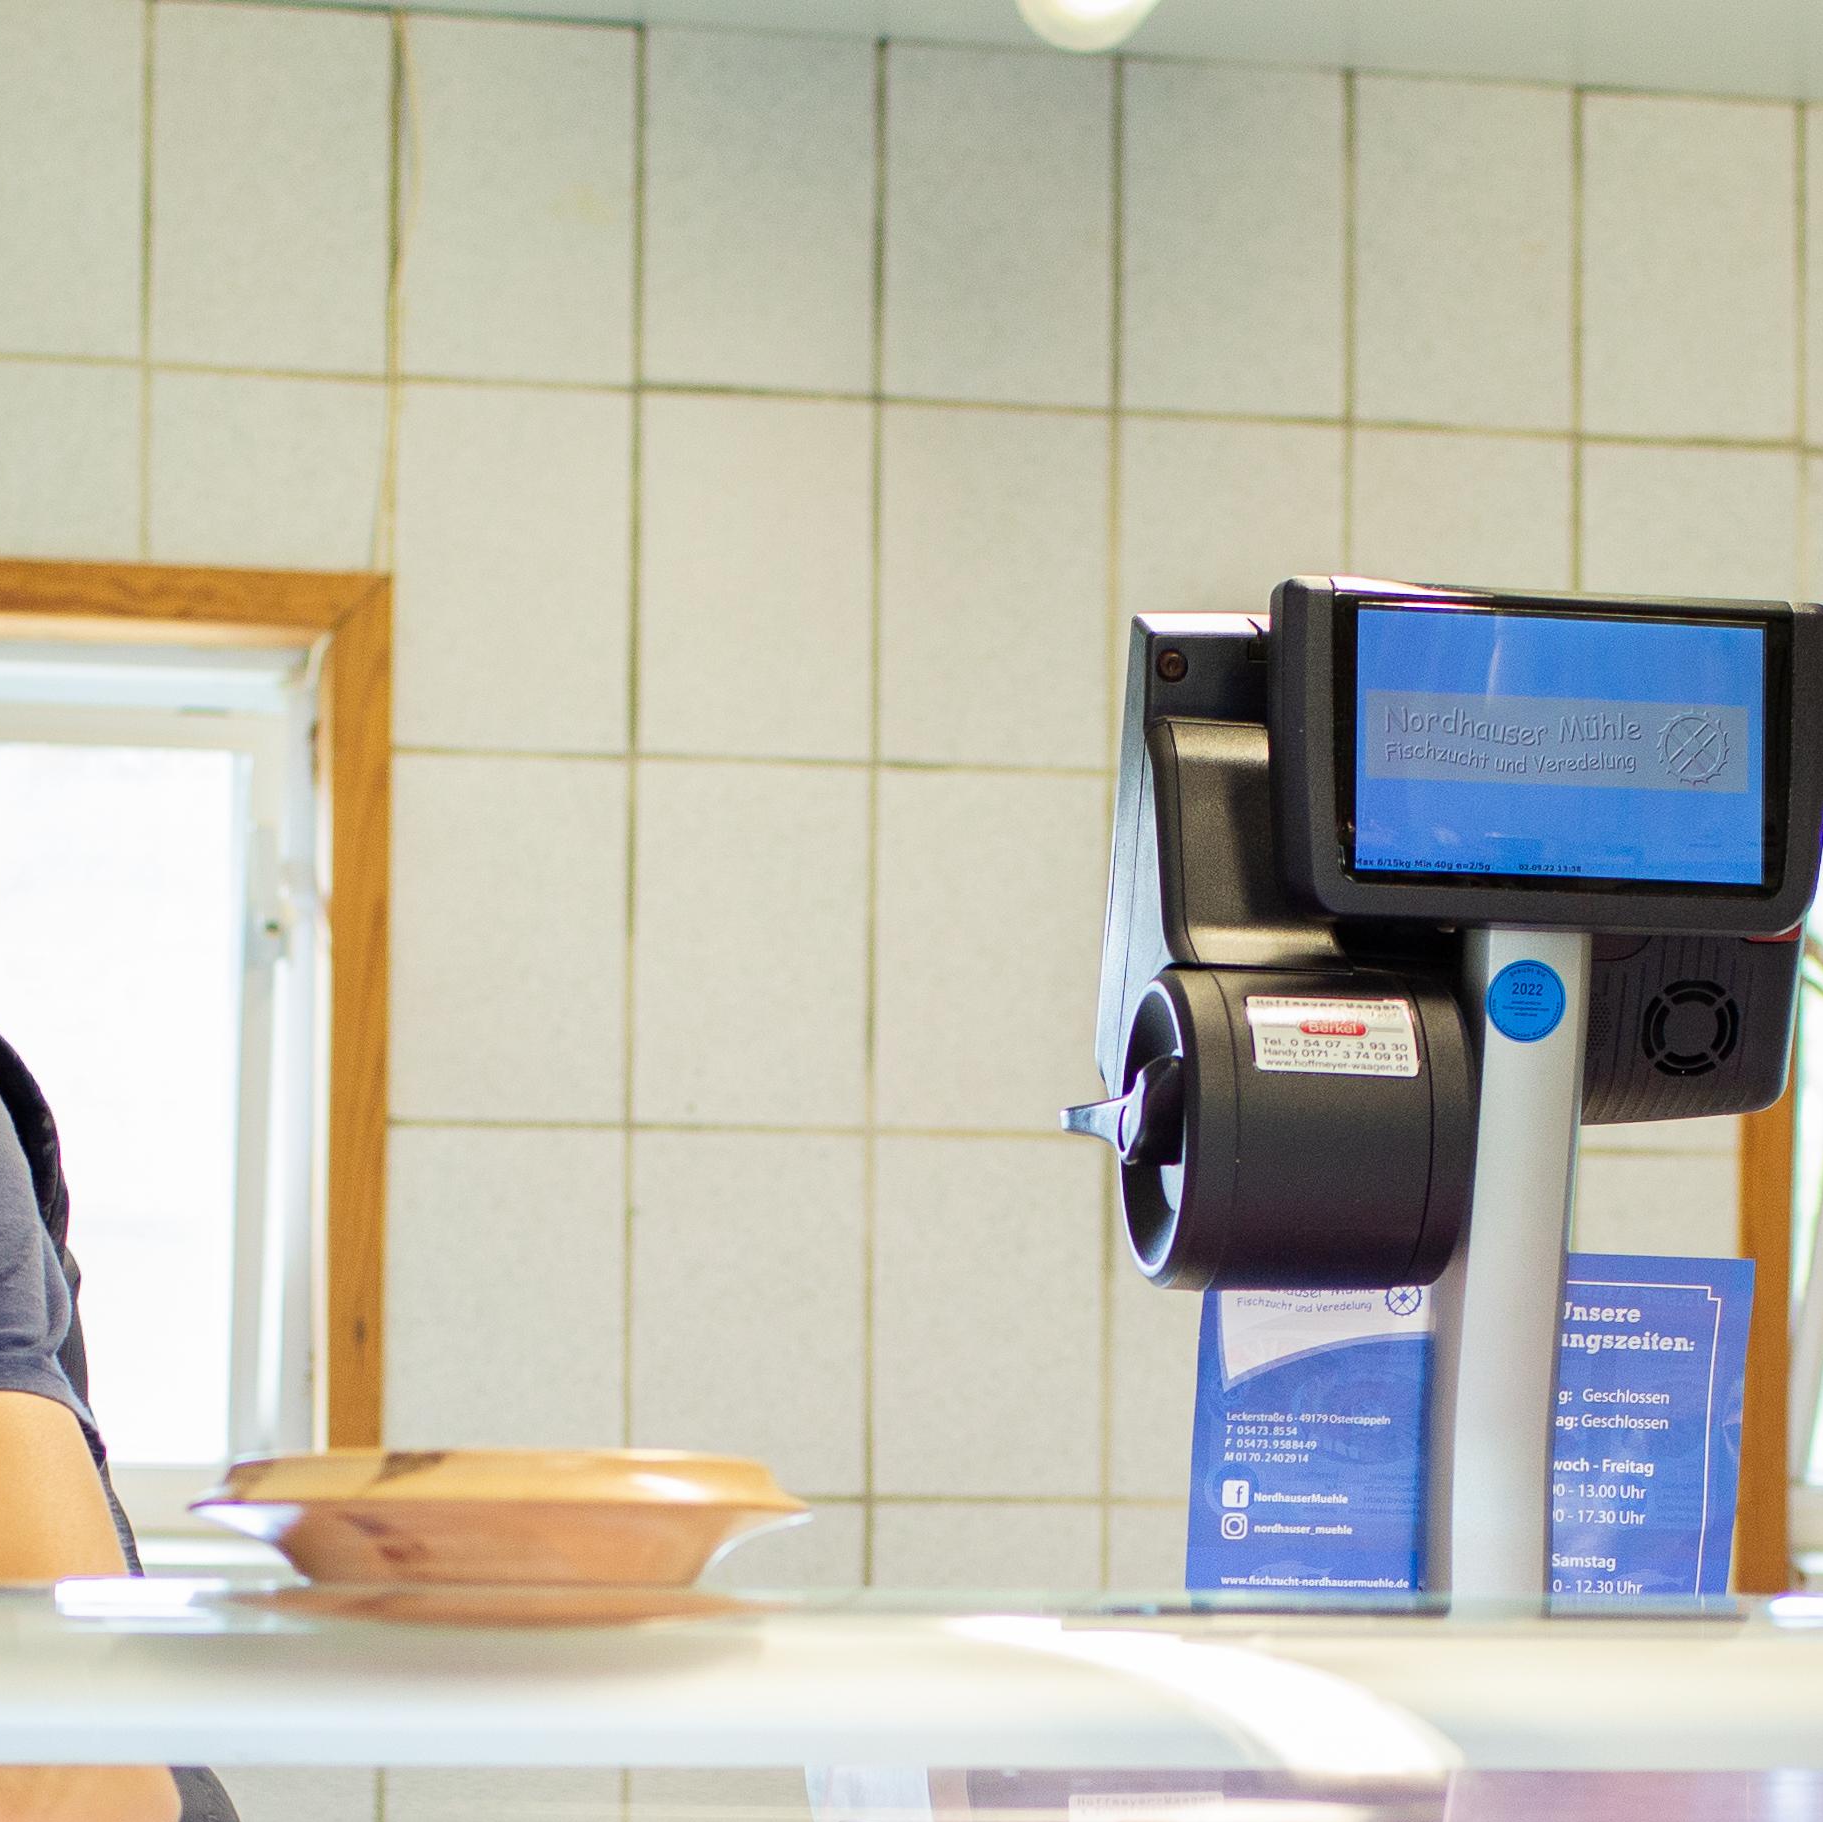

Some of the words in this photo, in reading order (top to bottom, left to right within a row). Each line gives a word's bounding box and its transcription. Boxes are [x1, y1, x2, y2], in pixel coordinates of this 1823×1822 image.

[1384, 706, 1548, 746] Nordhauser
[1559, 712, 1642, 743] Mühle
[1385, 742, 1490, 769] Fischzucht
[1495, 756, 1527, 774] und
[1532, 752, 1636, 774] Veredelung
[1512, 982, 1544, 997] 2022
[1308, 1021, 1357, 1035] Berkel
[1263, 1037, 1286, 1047] Tel.
[1290, 1039, 1298, 1047] 0
[1303, 1039, 1320, 1048] 54
[1325, 1039, 1341, 1049] 07
[1357, 1041, 1364, 1050] 3
[1370, 1042, 1386, 1051] 93
[1391, 1043, 1408, 1052] 30
[1264, 1048, 1297, 1058] Handy
[1301, 1048, 1328, 1058] 0171
[1342, 1050, 1350, 1059] 3
[1354, 1051, 1370, 1060] 74
[1374, 1051, 1391, 1061] 09
[1394, 1053, 1408, 1062] 91
[1265, 1059, 1409, 1073] www.hoffmeyer-waagen.de
[1236, 1297, 1292, 1311] Fischzucht
[1295, 1302, 1313, 1313] und
[1316, 1300, 1372, 1313] Veredelung
[1582, 1388, 1670, 1405] Geschlossen
[1227, 1411, 1285, 1422] Leckerstraße
[1286, 1413, 1293, 1422] 6
[1299, 1414, 1328, 1424] 49179
[1329, 1414, 1391, 1427] Ostercappeln
[1581, 1414, 1669, 1430] Geschlossen
[1226, 1425, 1233, 1435] T
[1224, 1438, 1232, 1448] F
[1224, 1452, 1234, 1462] M
[1601, 1458, 1655, 1478] Freitag
[1253, 1492, 1349, 1504] NordhauserMuehle
[1578, 1484, 1617, 1499] 13.00
[1619, 1486, 1647, 1500] Uhr
[1578, 1509, 1616, 1524] 17.30
[1619, 1510, 1646, 1525] Uhr
[1254, 1523, 1353, 1535] nordhauser_muehle
[1551, 1553, 1617, 1572] Samstag
[1220, 1574, 1409, 1589] www.fischzucht-nordhausermuehle.de
[1576, 1580, 1614, 1594] 12.30
[1617, 1581, 1643, 1595] Uhr
